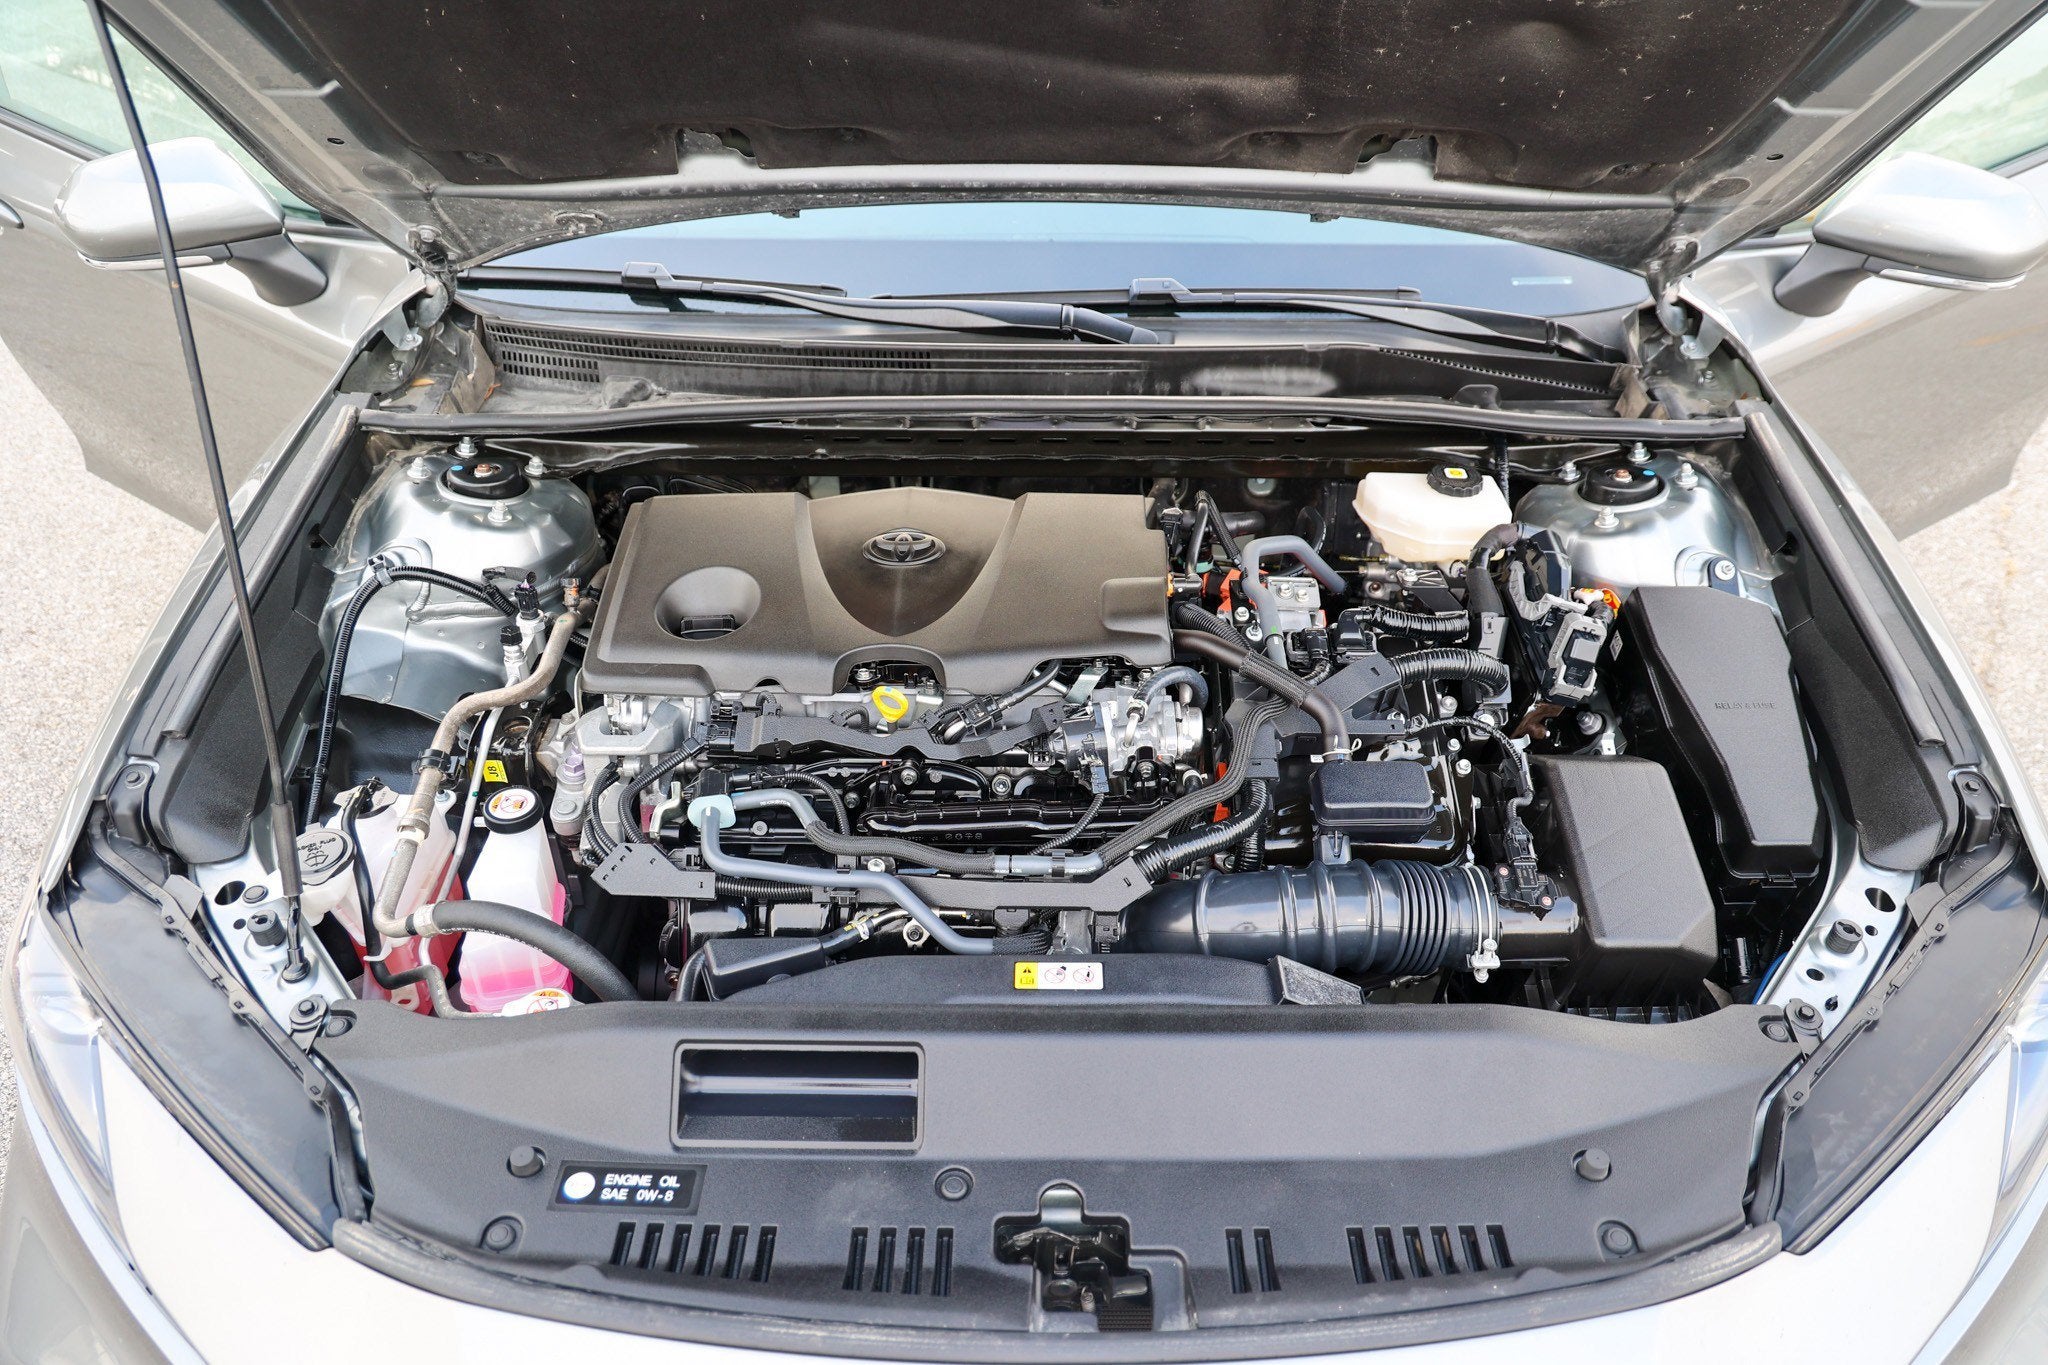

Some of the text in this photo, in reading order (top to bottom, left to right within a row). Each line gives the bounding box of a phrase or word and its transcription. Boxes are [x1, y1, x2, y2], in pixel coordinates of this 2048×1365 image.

[487, 766, 499, 777] J8
[604, 1173, 681, 1188] ENGINE OIL
[600, 1187, 675, 1202] SAE 0W-8
